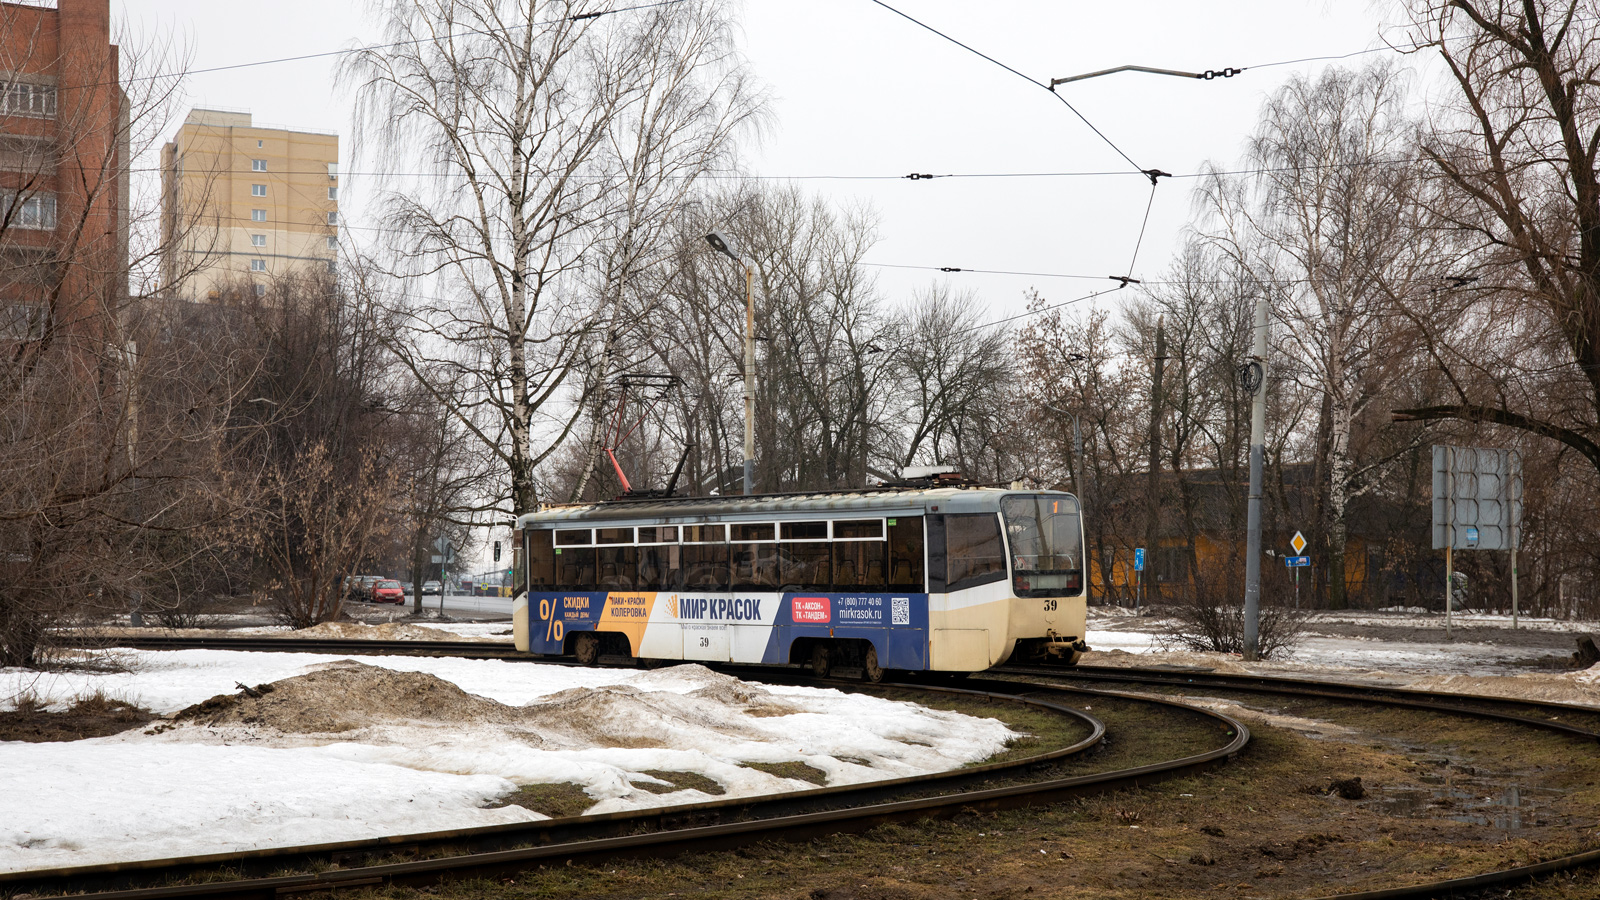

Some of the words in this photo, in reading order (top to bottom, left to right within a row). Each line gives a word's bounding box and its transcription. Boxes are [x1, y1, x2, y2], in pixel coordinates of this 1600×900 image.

[1053, 501, 1058, 513] 1
[563, 596, 590, 610] СКИДКИ
[627, 597, 646, 605] КРАСКИ
[795, 602, 802, 610] ТК
[802, 602, 823, 610] «АКСОН»
[844, 598, 858, 607] (800)
[1043, 599, 1057, 611] 39
[611, 607, 647, 617] КОЛЕРОВКА
[680, 599, 707, 619] МИР
[709, 599, 761, 620] КРАСОК
[839, 608, 882, 619] mirkrasok.ru
[539, 598, 564, 642] %
[796, 611, 802, 619] ТК
[802, 611, 828, 620] «ТАНДЕМ»
[699, 637, 710, 647] 39
